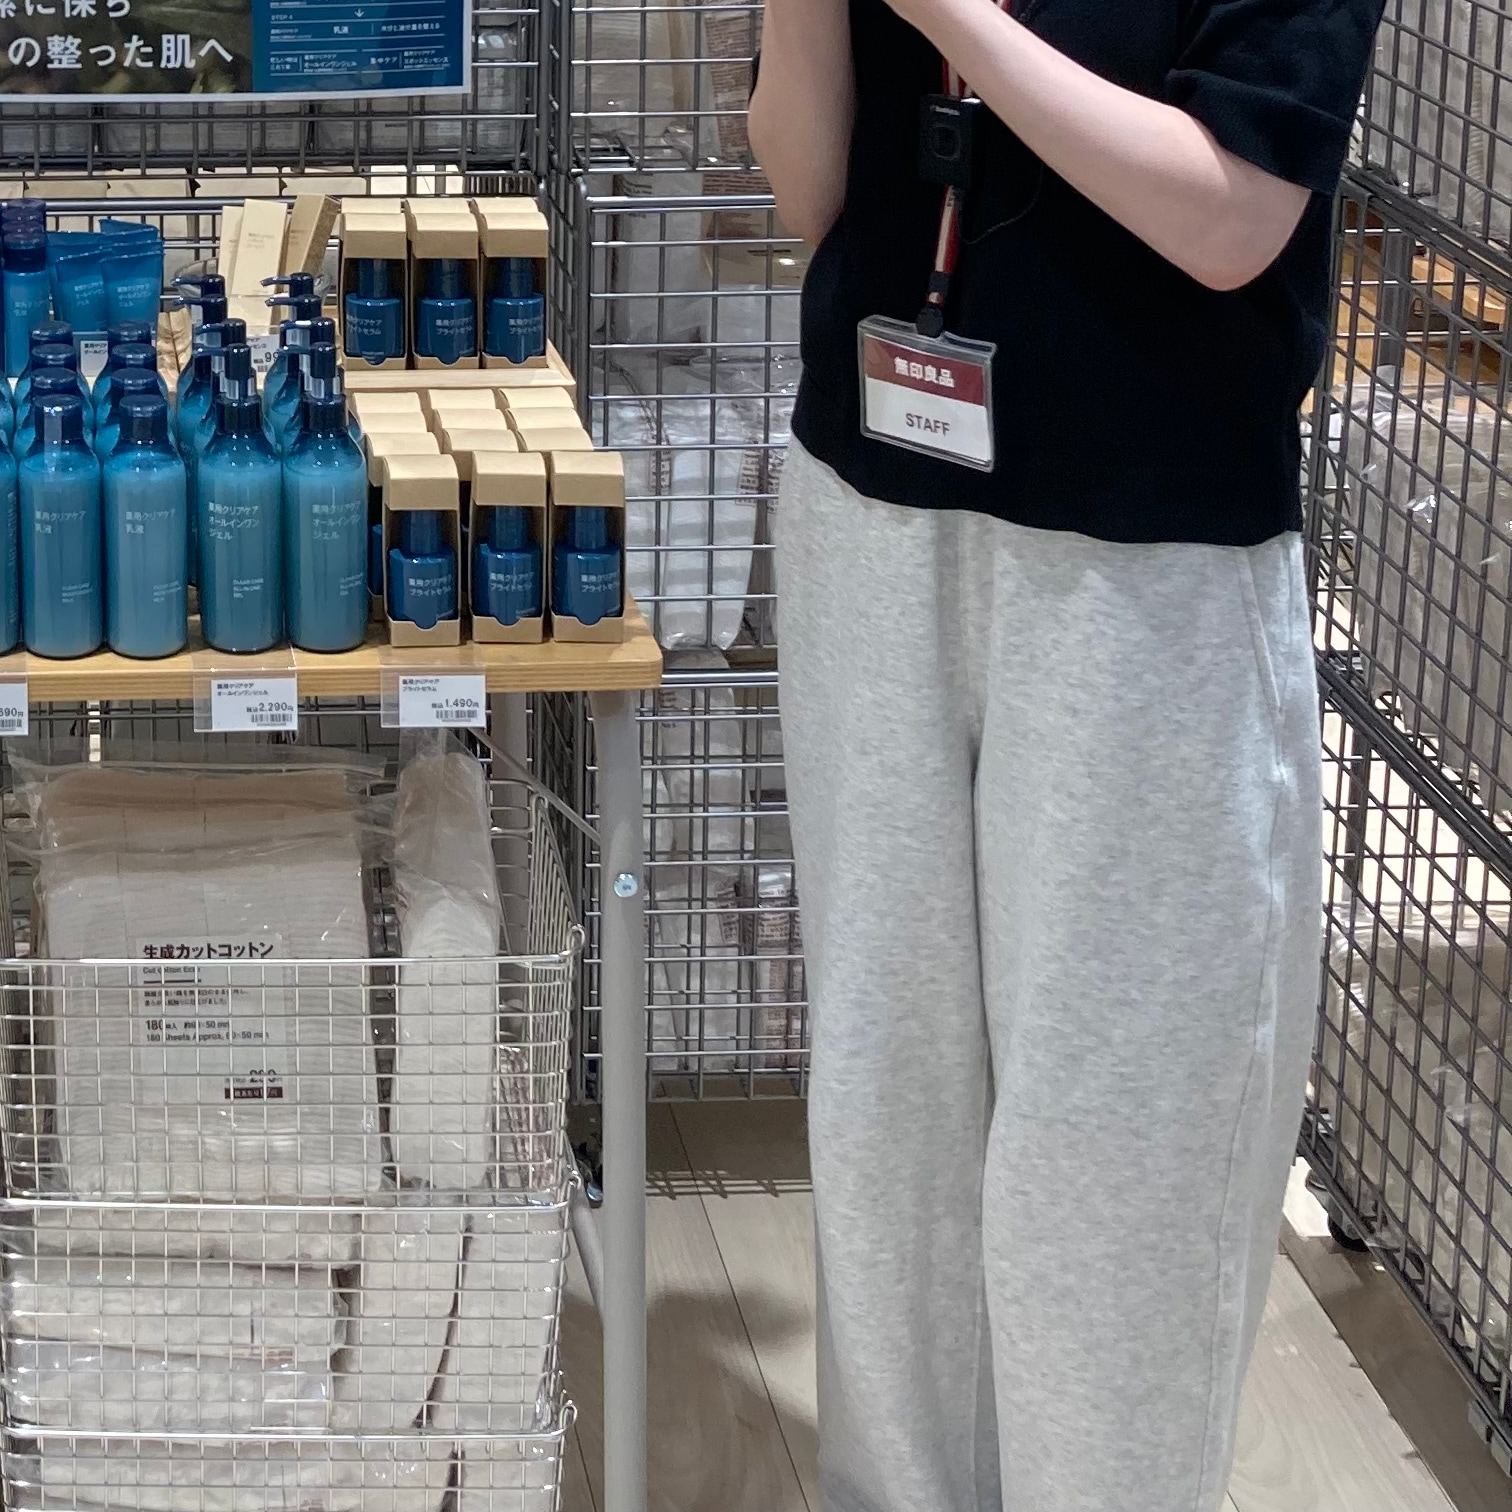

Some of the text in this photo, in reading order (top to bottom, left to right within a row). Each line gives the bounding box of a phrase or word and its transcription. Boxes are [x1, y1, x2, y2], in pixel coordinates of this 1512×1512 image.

[894, 356, 954, 388] 無印良品
[905, 413, 951, 436] STAFF
[143, 941, 274, 959] 生成カットコットン
[164, 1033, 190, 1041] heets
